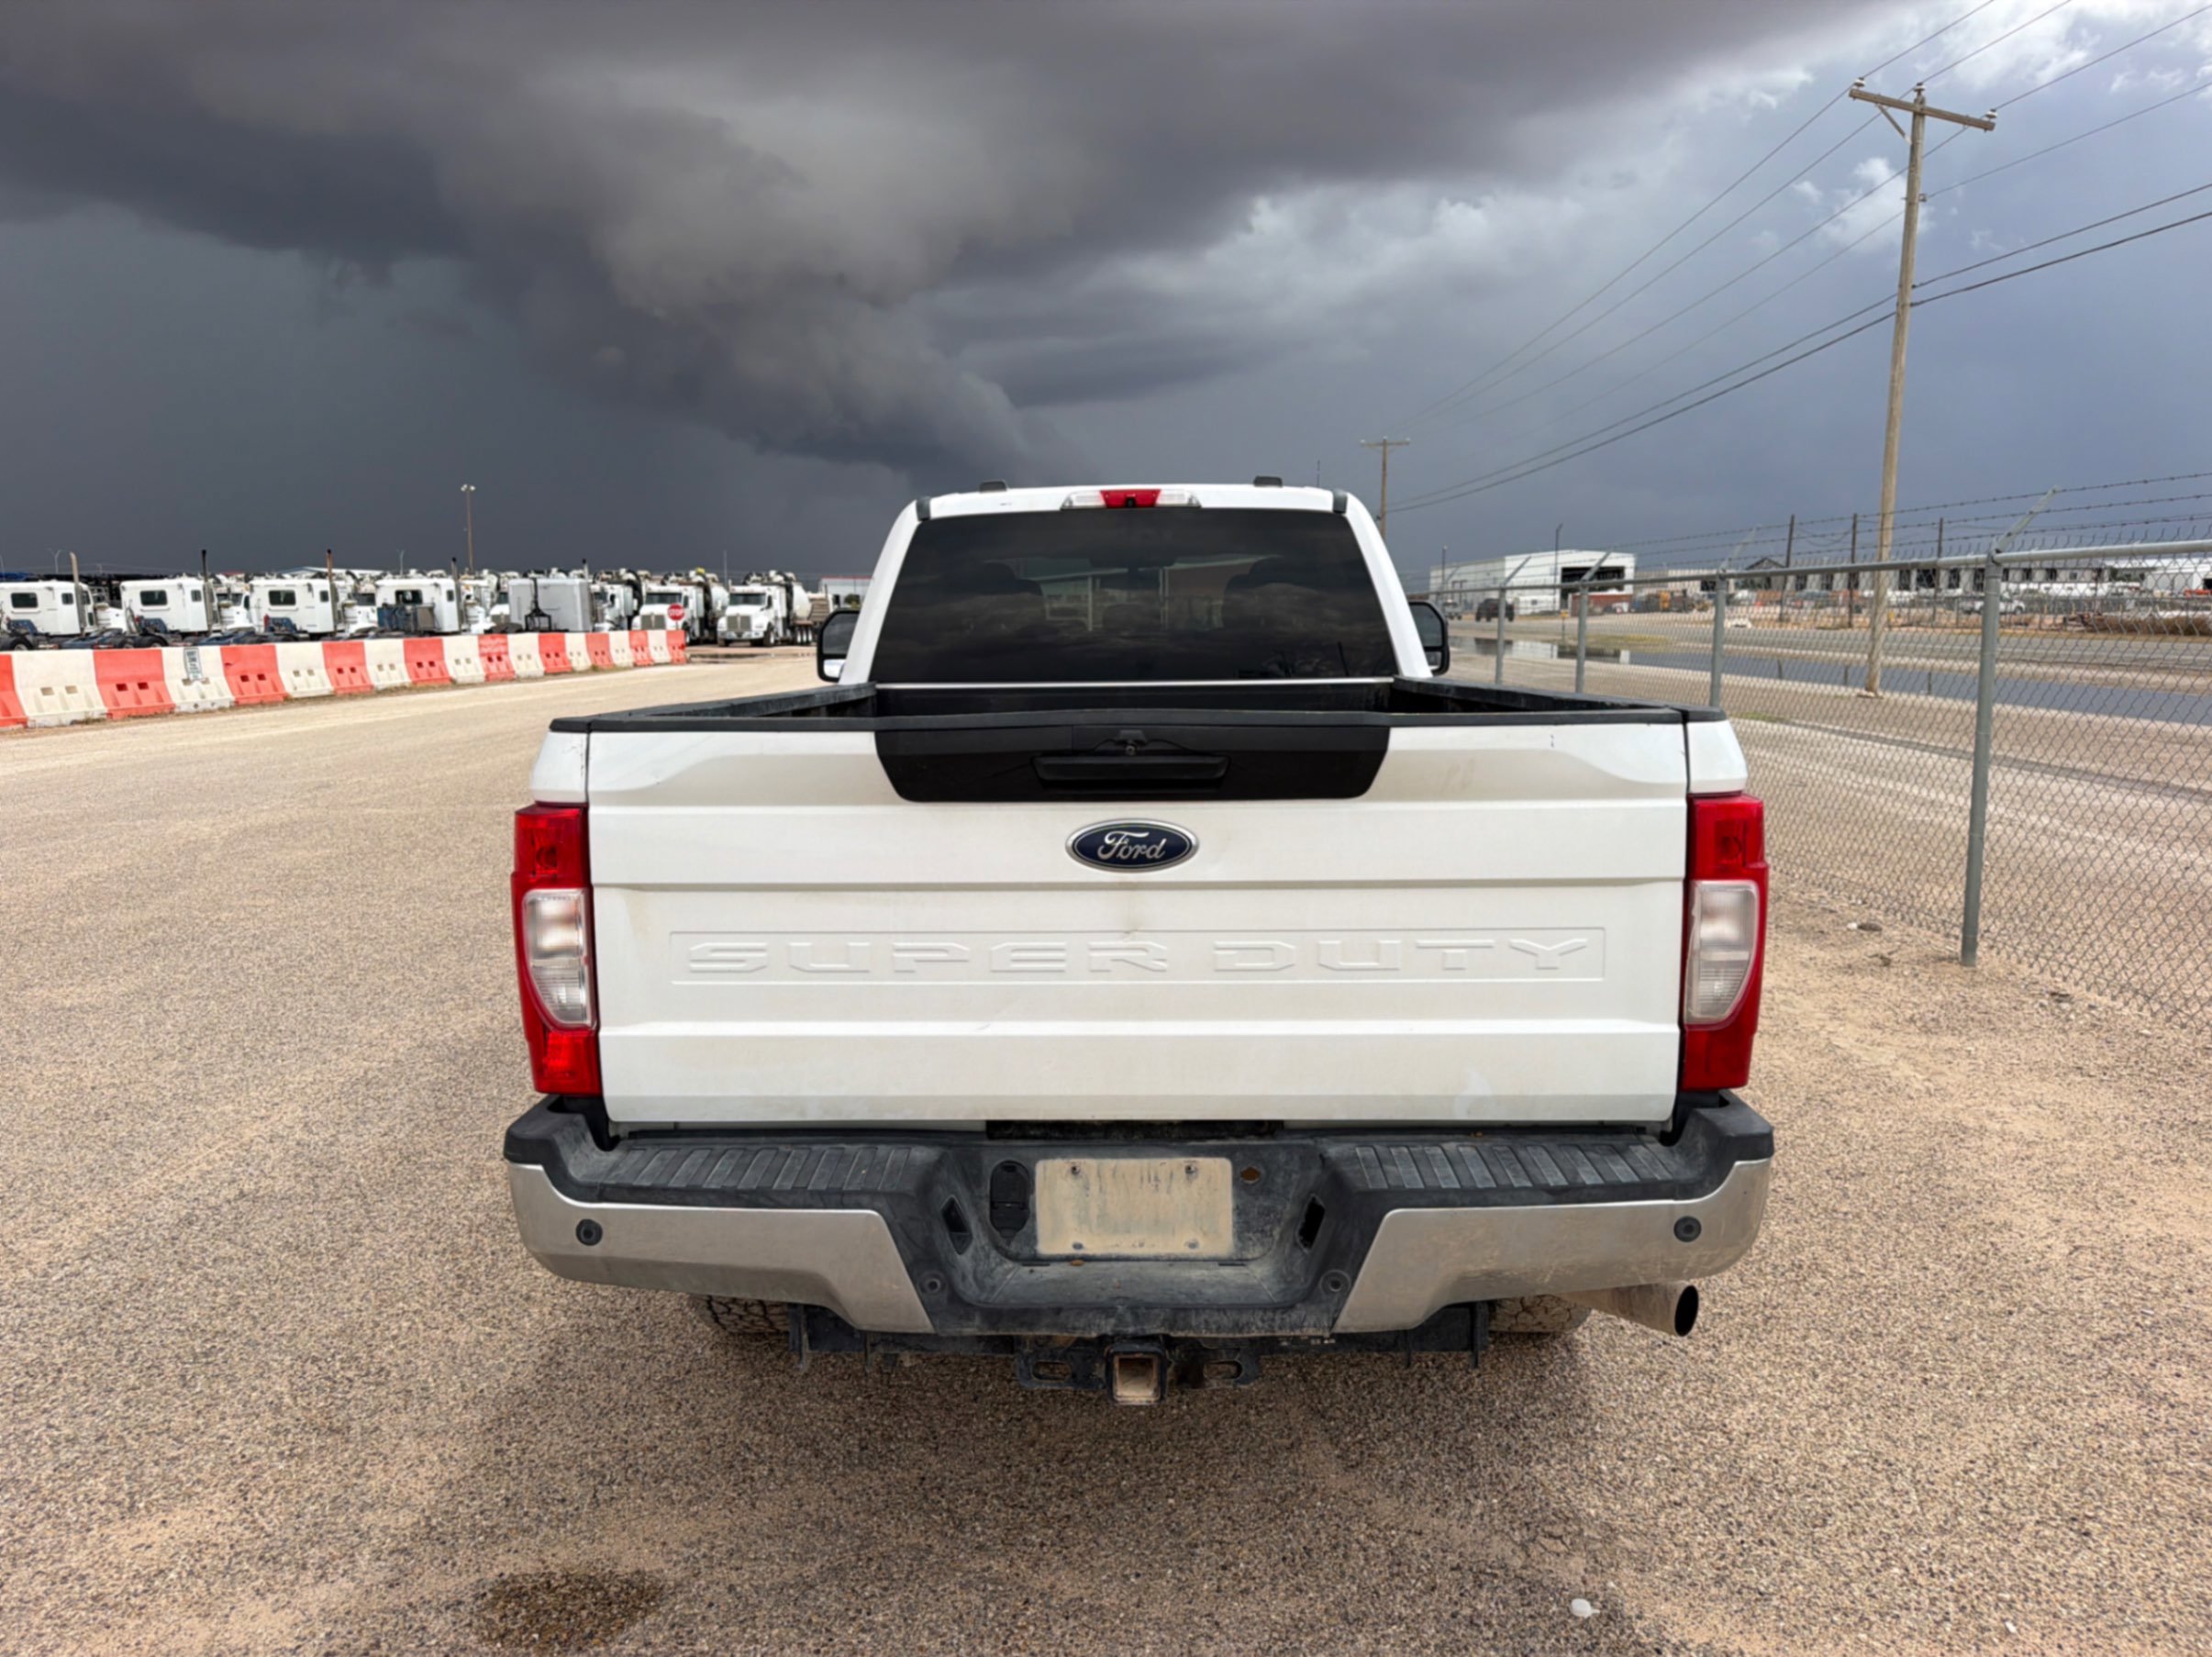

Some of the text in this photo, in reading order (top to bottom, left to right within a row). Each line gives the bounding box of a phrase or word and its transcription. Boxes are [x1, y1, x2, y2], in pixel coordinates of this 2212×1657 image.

[668, 607, 684, 617] STOP
[1097, 829, 1167, 860] Ford
[689, 938, 1588, 973] SUPER DUTY
